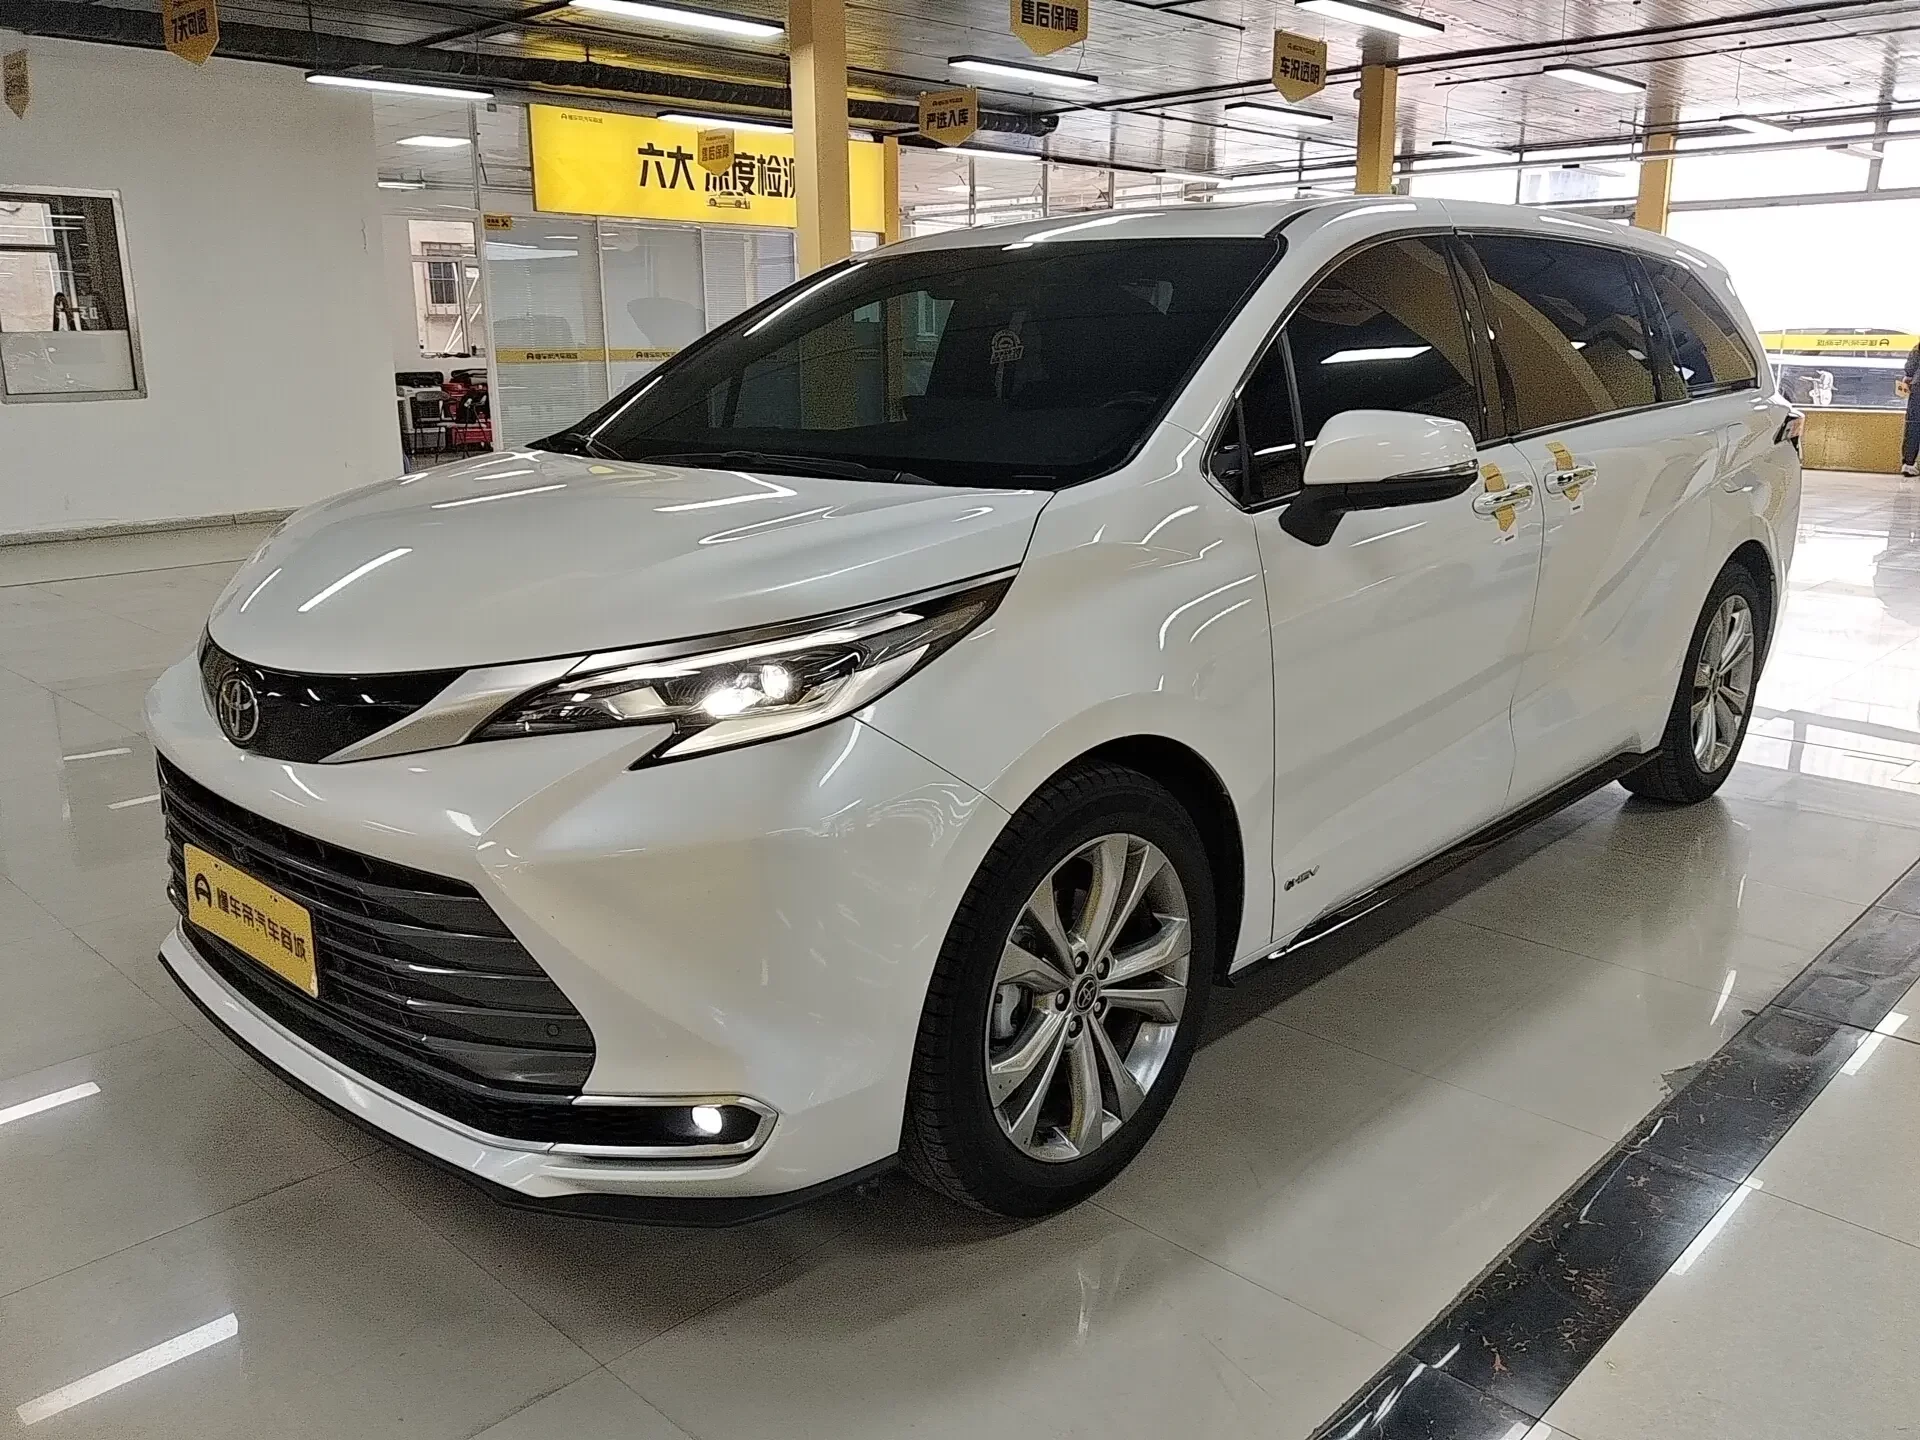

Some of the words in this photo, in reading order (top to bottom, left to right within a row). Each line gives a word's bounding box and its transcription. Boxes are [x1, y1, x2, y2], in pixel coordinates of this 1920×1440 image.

[1021, 0, 1079, 32] 售后保障
[1280, 56, 1320, 86] 车况透明
[926, 108, 969, 130] 严选入库
[637, 142, 696, 190] 六大
[216, 886, 307, 963] 懂车帝汽车商城
